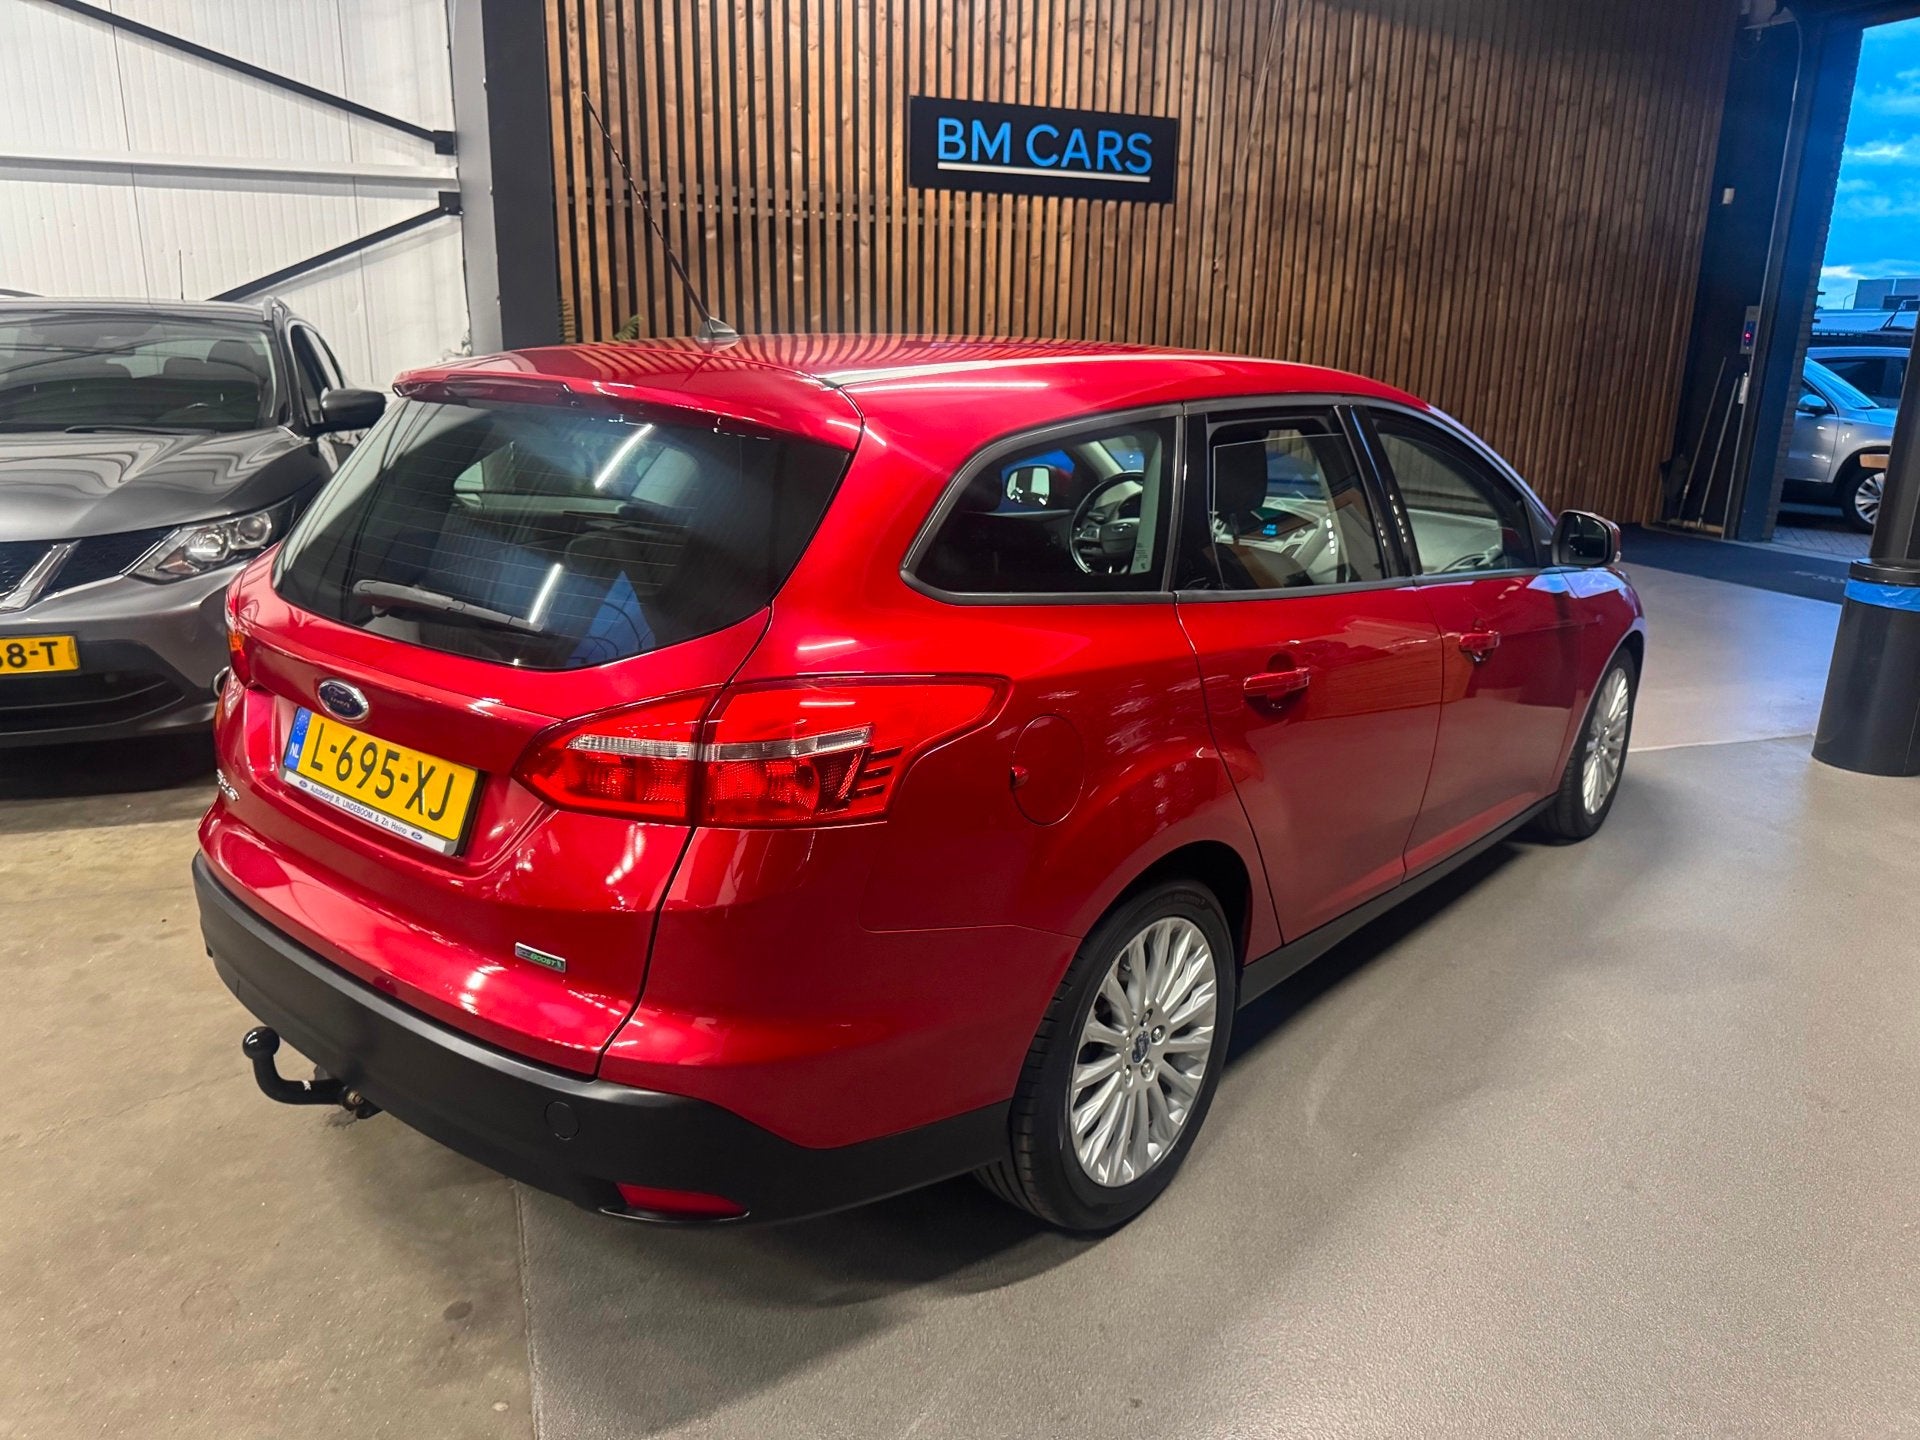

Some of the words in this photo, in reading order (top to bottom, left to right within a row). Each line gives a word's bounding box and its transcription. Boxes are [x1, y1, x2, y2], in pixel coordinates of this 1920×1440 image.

[937, 117, 1012, 164] BM
[1026, 123, 1153, 174] CARS
[0, 641, 58, 669] 8-T
[289, 742, 300, 759] NL
[310, 723, 455, 821] L-695-XJ
[342, 799, 374, 819] LINDEBOOM
